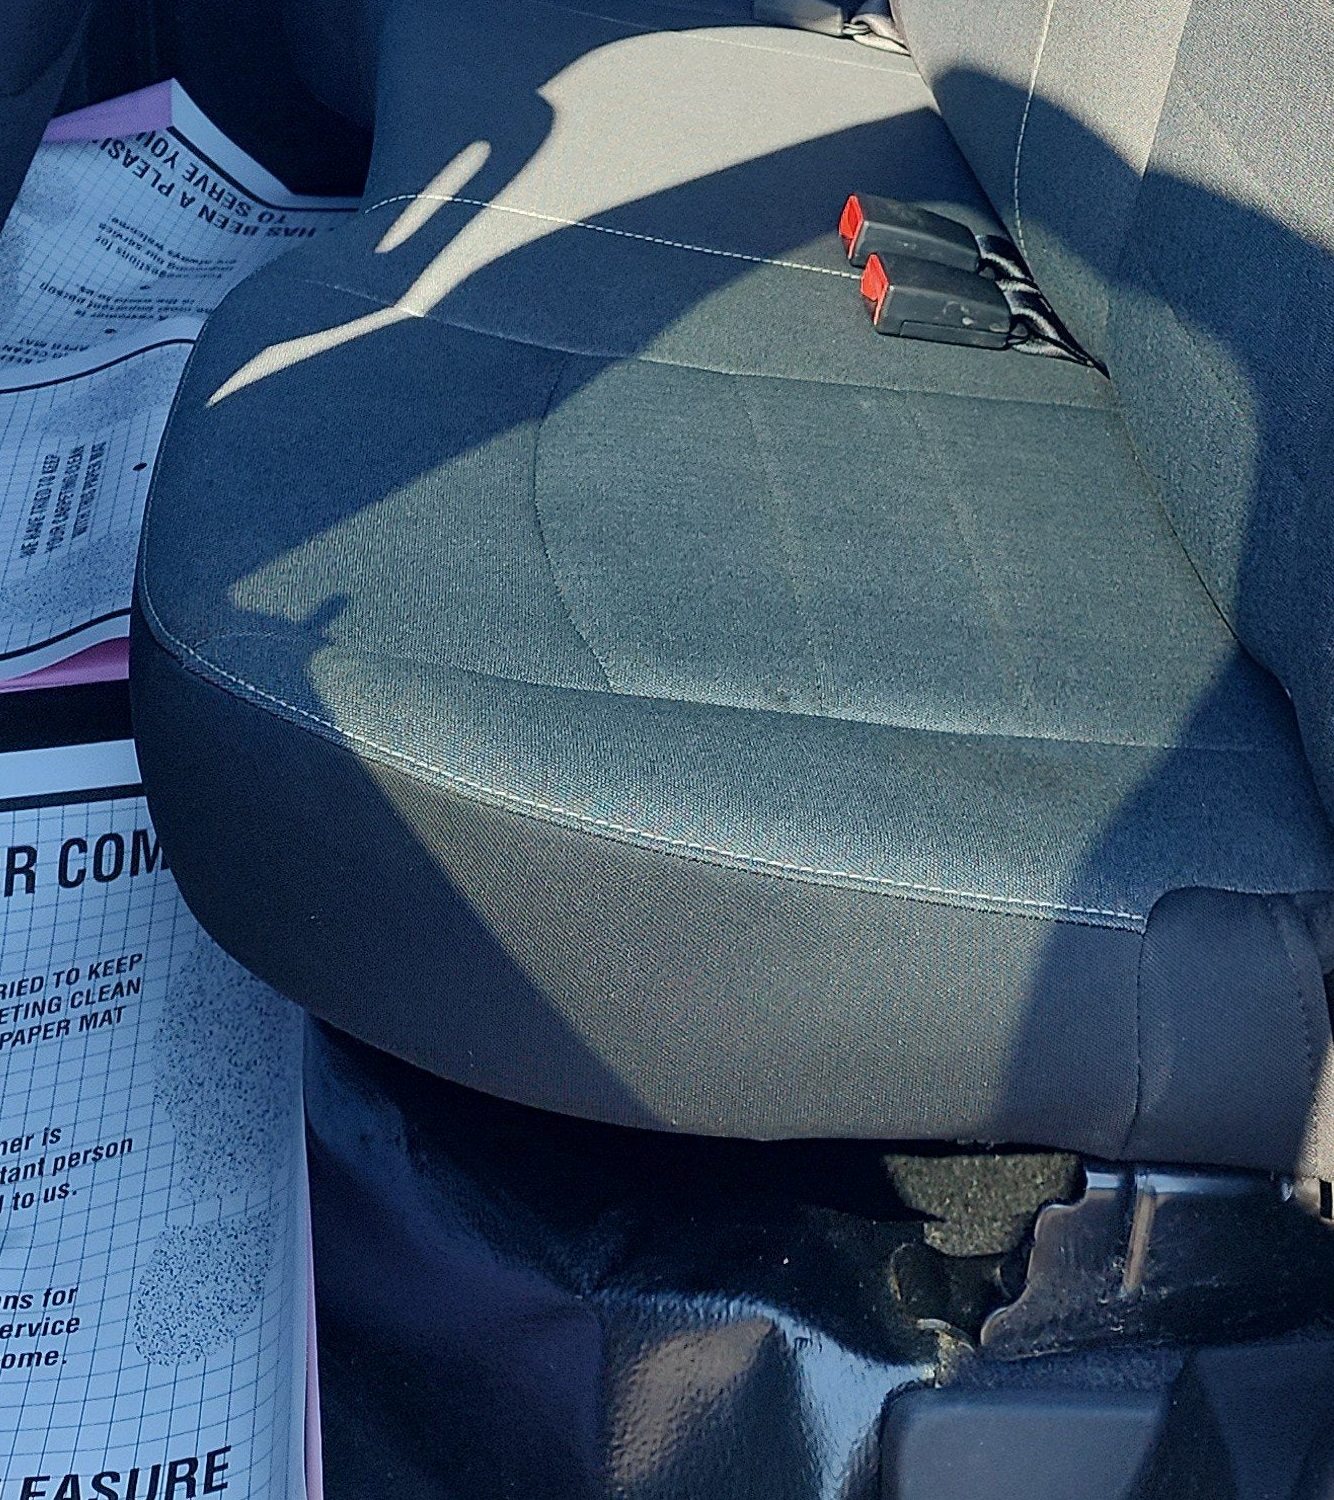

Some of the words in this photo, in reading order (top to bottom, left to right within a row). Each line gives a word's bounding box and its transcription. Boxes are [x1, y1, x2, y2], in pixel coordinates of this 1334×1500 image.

[179, 190, 197, 210] A
[181, 161, 253, 218] SERVE
[197, 204, 259, 237] BEEN
[256, 210, 288, 224] TO
[57, 828, 171, 889] COM
[53, 967, 80, 988] TO
[87, 953, 144, 981] KEEP
[69, 976, 142, 1009] CLEAN
[78, 1005, 127, 1032] MAT
[41, 1126, 62, 1147] is
[51, 1136, 135, 1176] person
[12, 1190, 35, 1212] to
[43, 1180, 78, 1203] us.
[42, 1286, 80, 1308] for
